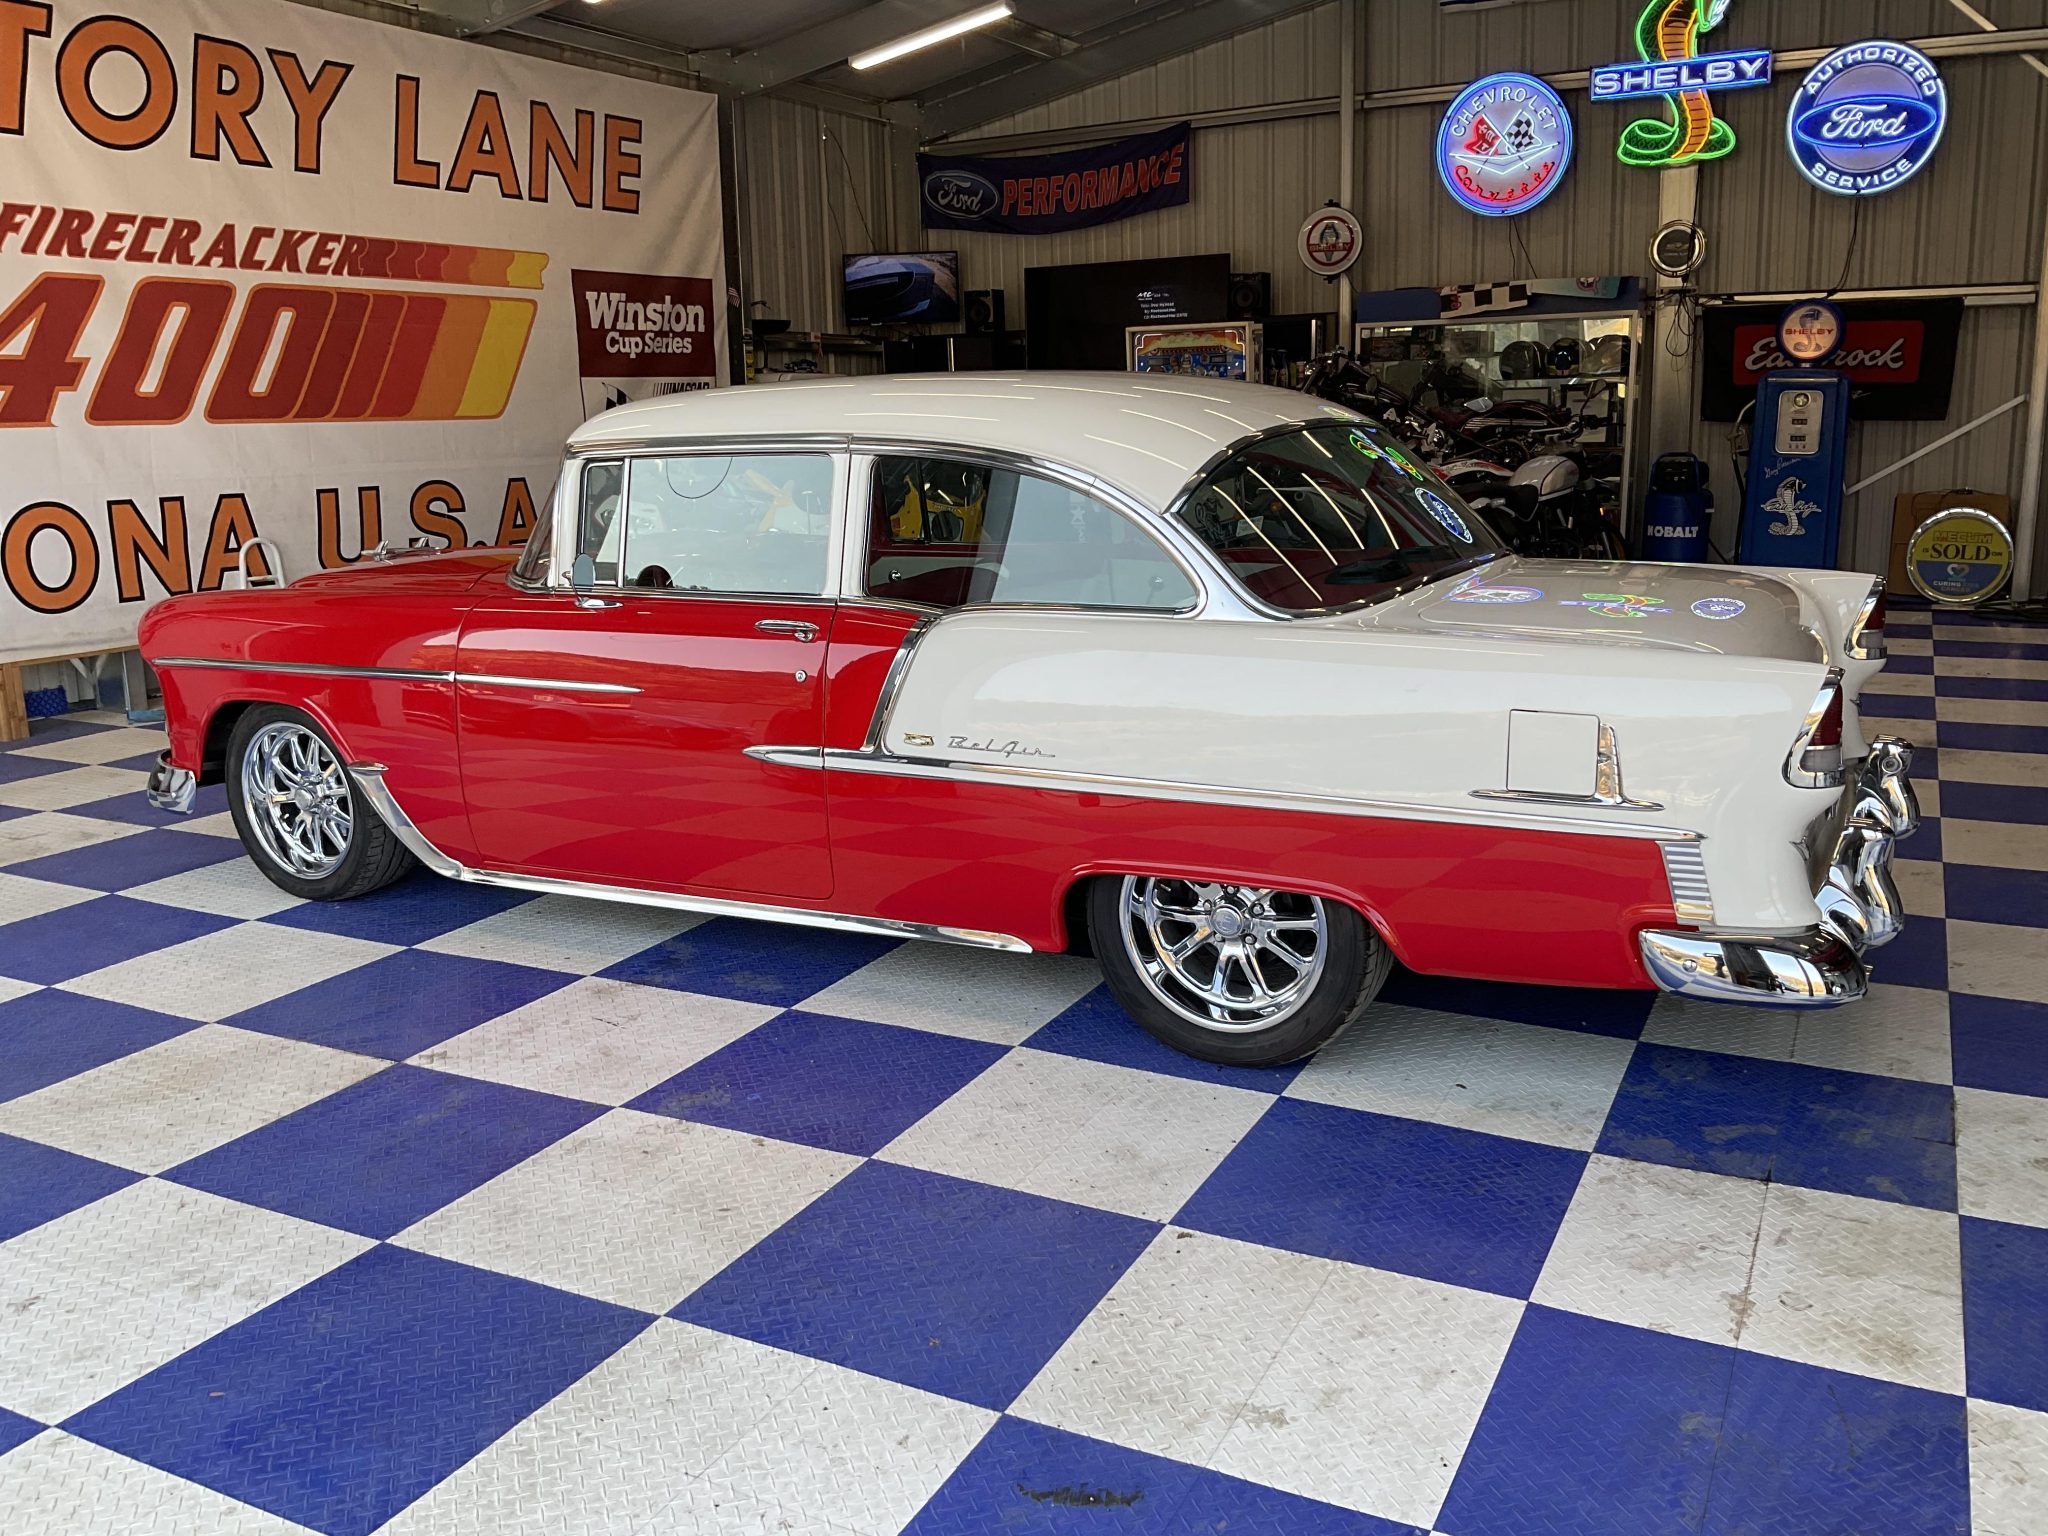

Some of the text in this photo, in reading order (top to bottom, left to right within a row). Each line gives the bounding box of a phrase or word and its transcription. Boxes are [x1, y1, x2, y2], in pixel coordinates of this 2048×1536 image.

[1594, 56, 1767, 95] SHELBY
[1806, 47, 1937, 96] AUTHORIZED
[0, 0, 643, 214] TORY LANE
[1451, 86, 1558, 137] CHEVROLET
[1821, 103, 1908, 139] Ford
[936, 141, 1185, 217] Ford PERFORMANCE
[1812, 157, 1914, 188] SERVICE
[0, 202, 364, 278] FIRECRACKER
[585, 290, 705, 333] Winston
[1784, 327, 1835, 336] SHELBY
[0, 271, 338, 428] 400
[605, 331, 693, 359] Cup Series
[1930, 543, 1991, 561] SOLD
[1933, 530, 1994, 545] MECUM
